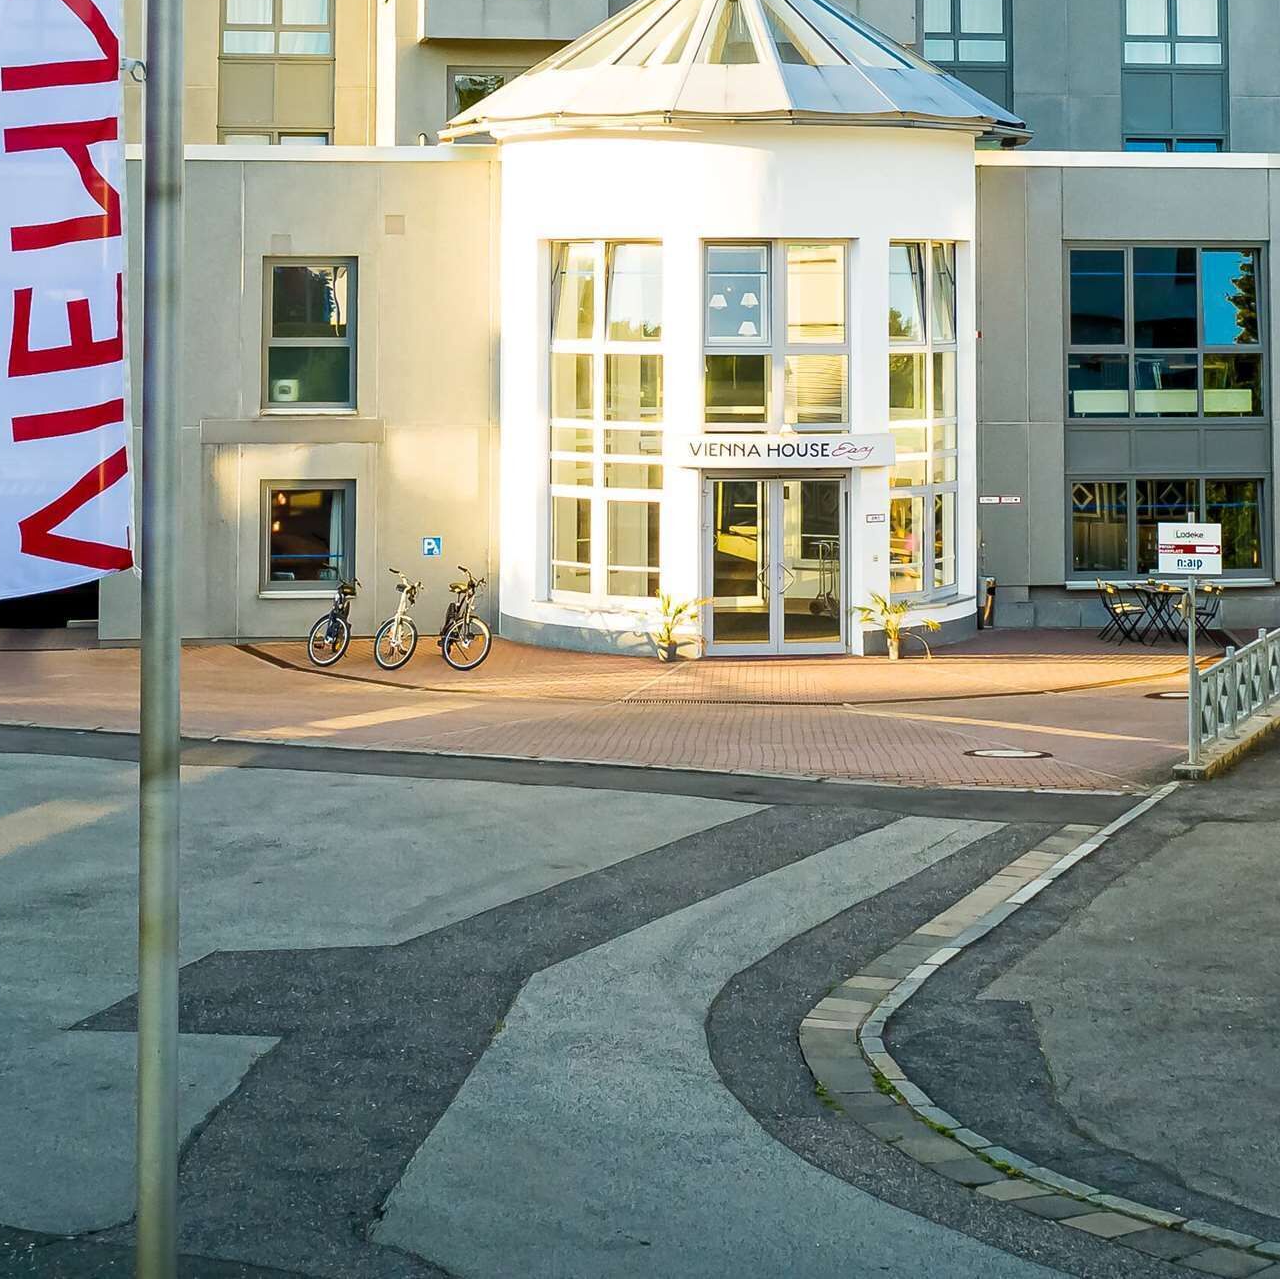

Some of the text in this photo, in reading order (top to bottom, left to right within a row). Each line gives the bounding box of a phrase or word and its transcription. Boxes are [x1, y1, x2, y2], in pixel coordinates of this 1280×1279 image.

[689, 441, 875, 461] VIENNA HOUSE Easy
